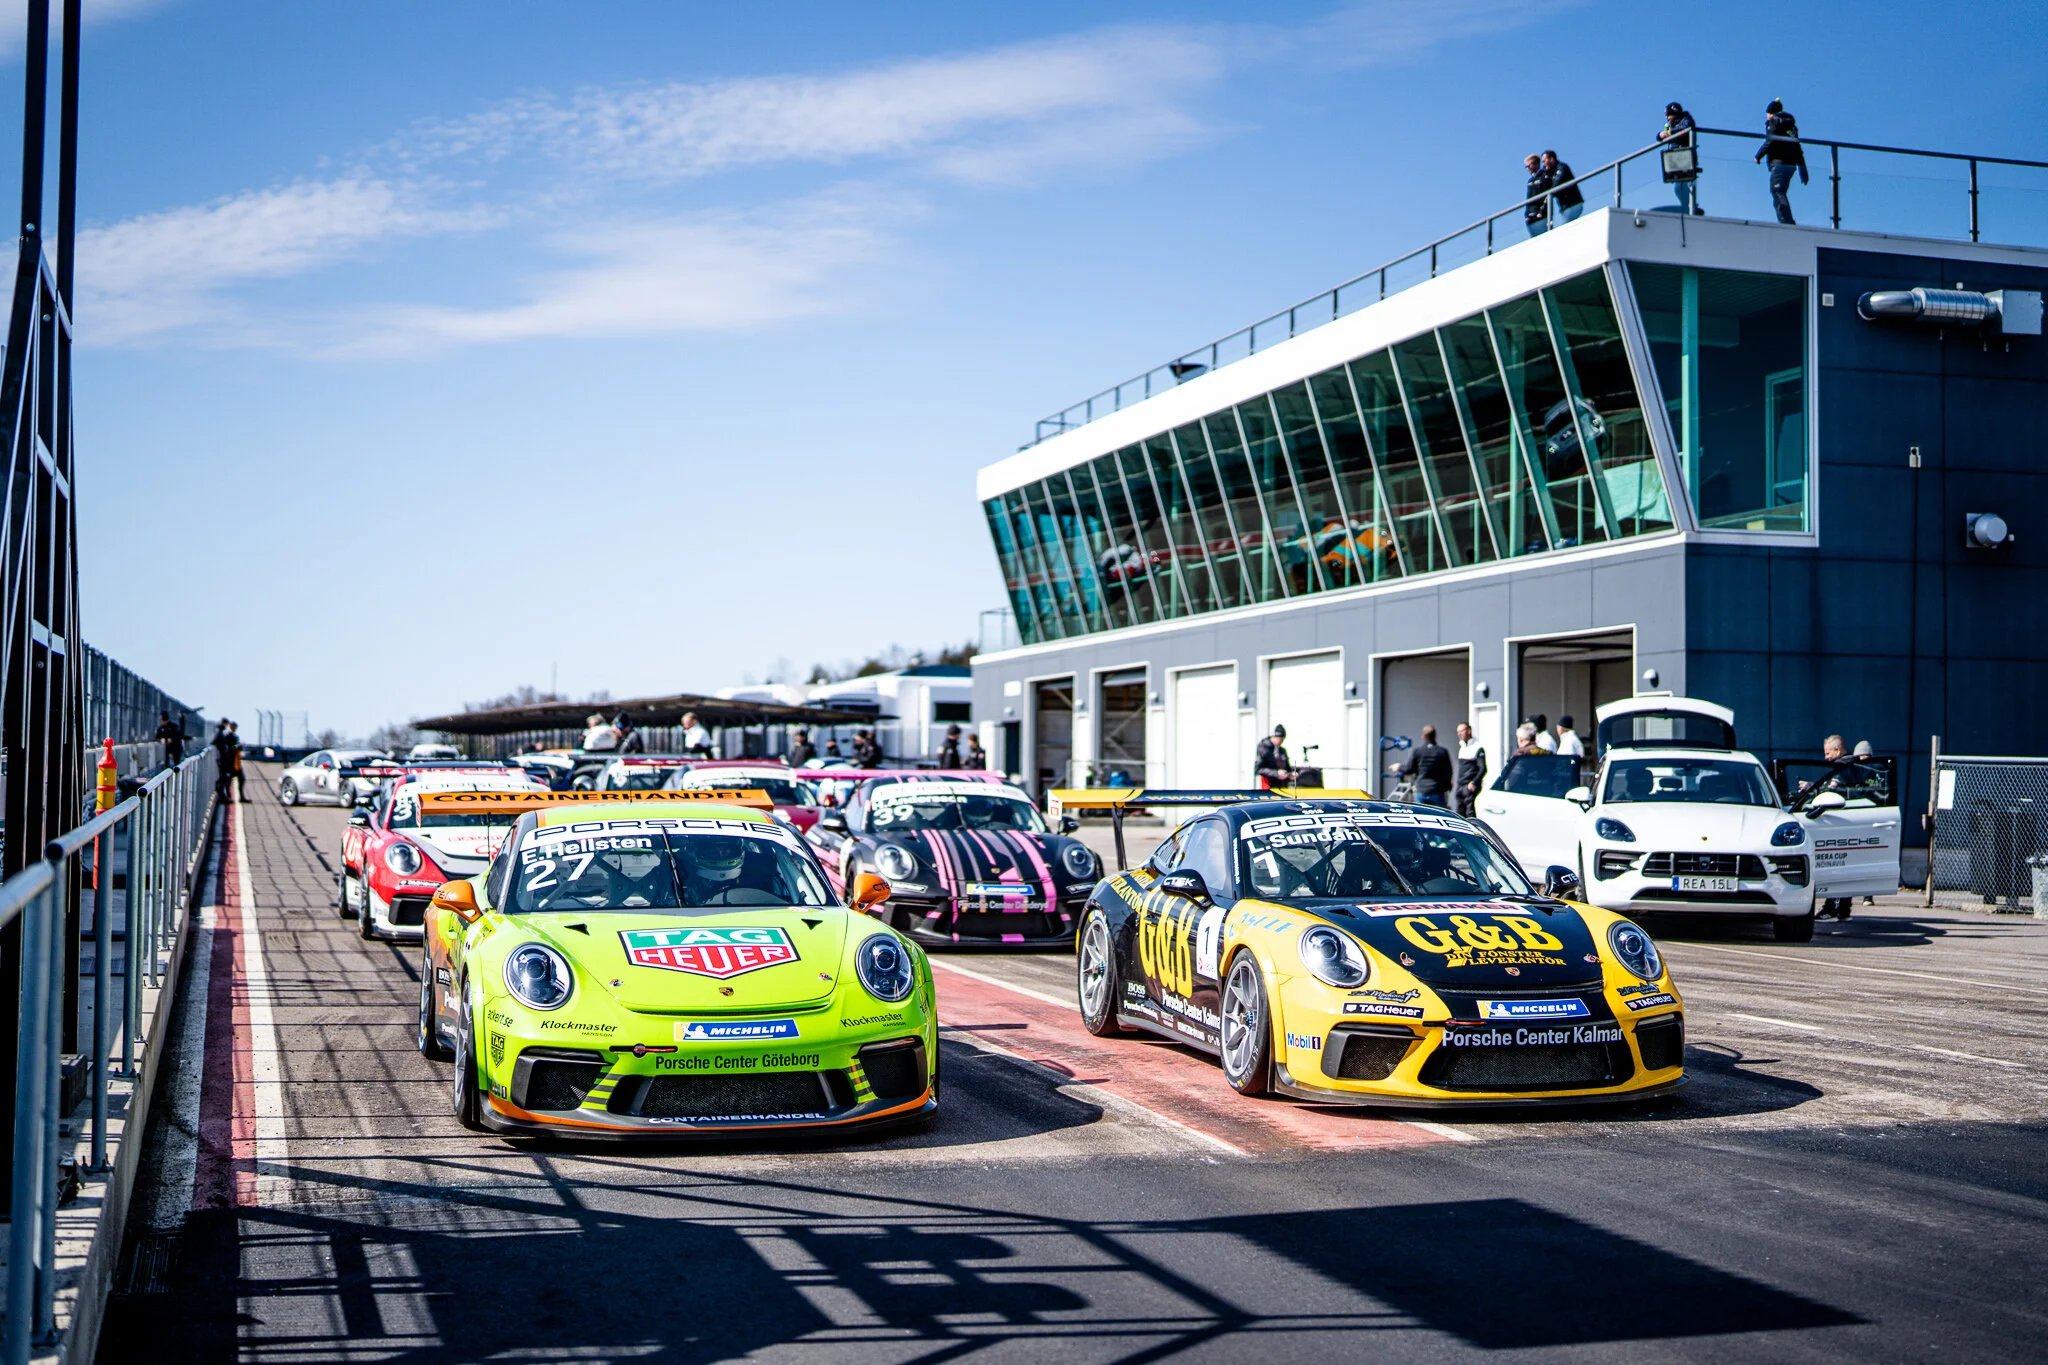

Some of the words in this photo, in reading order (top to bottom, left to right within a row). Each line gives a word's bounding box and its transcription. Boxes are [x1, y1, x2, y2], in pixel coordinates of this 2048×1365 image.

[433, 791, 752, 802] CONTAINERHANDEL
[871, 795, 968, 811] H.Andersson
[873, 804, 914, 826] 39
[533, 819, 784, 841] PORSCHE
[1251, 815, 1477, 834] PORSCHE
[1247, 829, 1368, 854] L.Sundahl
[1815, 837, 1880, 847] ORSCHE
[521, 837, 652, 866] E.Hellsten
[1815, 853, 1834, 861] RERA
[1834, 852, 1848, 860] CUP
[524, 852, 595, 893] 27
[1253, 852, 1281, 879] 1
[1815, 860, 1846, 869] NDINAVIA
[1163, 876, 1196, 887] CTEK
[1560, 873, 1577, 883] CTE
[1683, 878, 1706, 890] REA
[1711, 878, 1733, 890] 15L
[872, 881, 890, 892] CTE
[1365, 903, 1521, 913] FOGMAKER
[636, 929, 774, 946] TAG
[1139, 887, 1193, 998] G&B
[1204, 926, 1211, 955] 1
[1394, 915, 1565, 954] G&B
[639, 946, 786, 973] HEUER
[1445, 952, 1473, 961] DIN
[1477, 950, 1546, 959] FÖNSTER
[1469, 956, 1568, 967] LEVERANTÖR
[1127, 982, 1146, 995] BOSS
[1511, 1002, 1577, 1013] MICHELIN
[1635, 995, 1673, 1007] TAGHeuer
[1202, 1006, 1221, 1030] Kalma
[1359, 1004, 1421, 1016] TAGHeuer
[540, 1020, 618, 1032] Klockmaster
[840, 1012, 904, 1028] Klockmaster
[709, 1024, 787, 1036] MICHELIN
[1442, 1028, 1513, 1048] Porsche
[1515, 1027, 1569, 1046] Center
[1573, 1025, 1624, 1044] Kalmar
[491, 1033, 505, 1049] TAG
[1287, 1032, 1311, 1049] Mobil
[1312, 1036, 1320, 1050] 1
[655, 1055, 713, 1069] Porsche
[714, 1055, 759, 1069] Center
[761, 1053, 820, 1068] Göteborg
[648, 1112, 826, 1124] CONTAINERHANDEL
